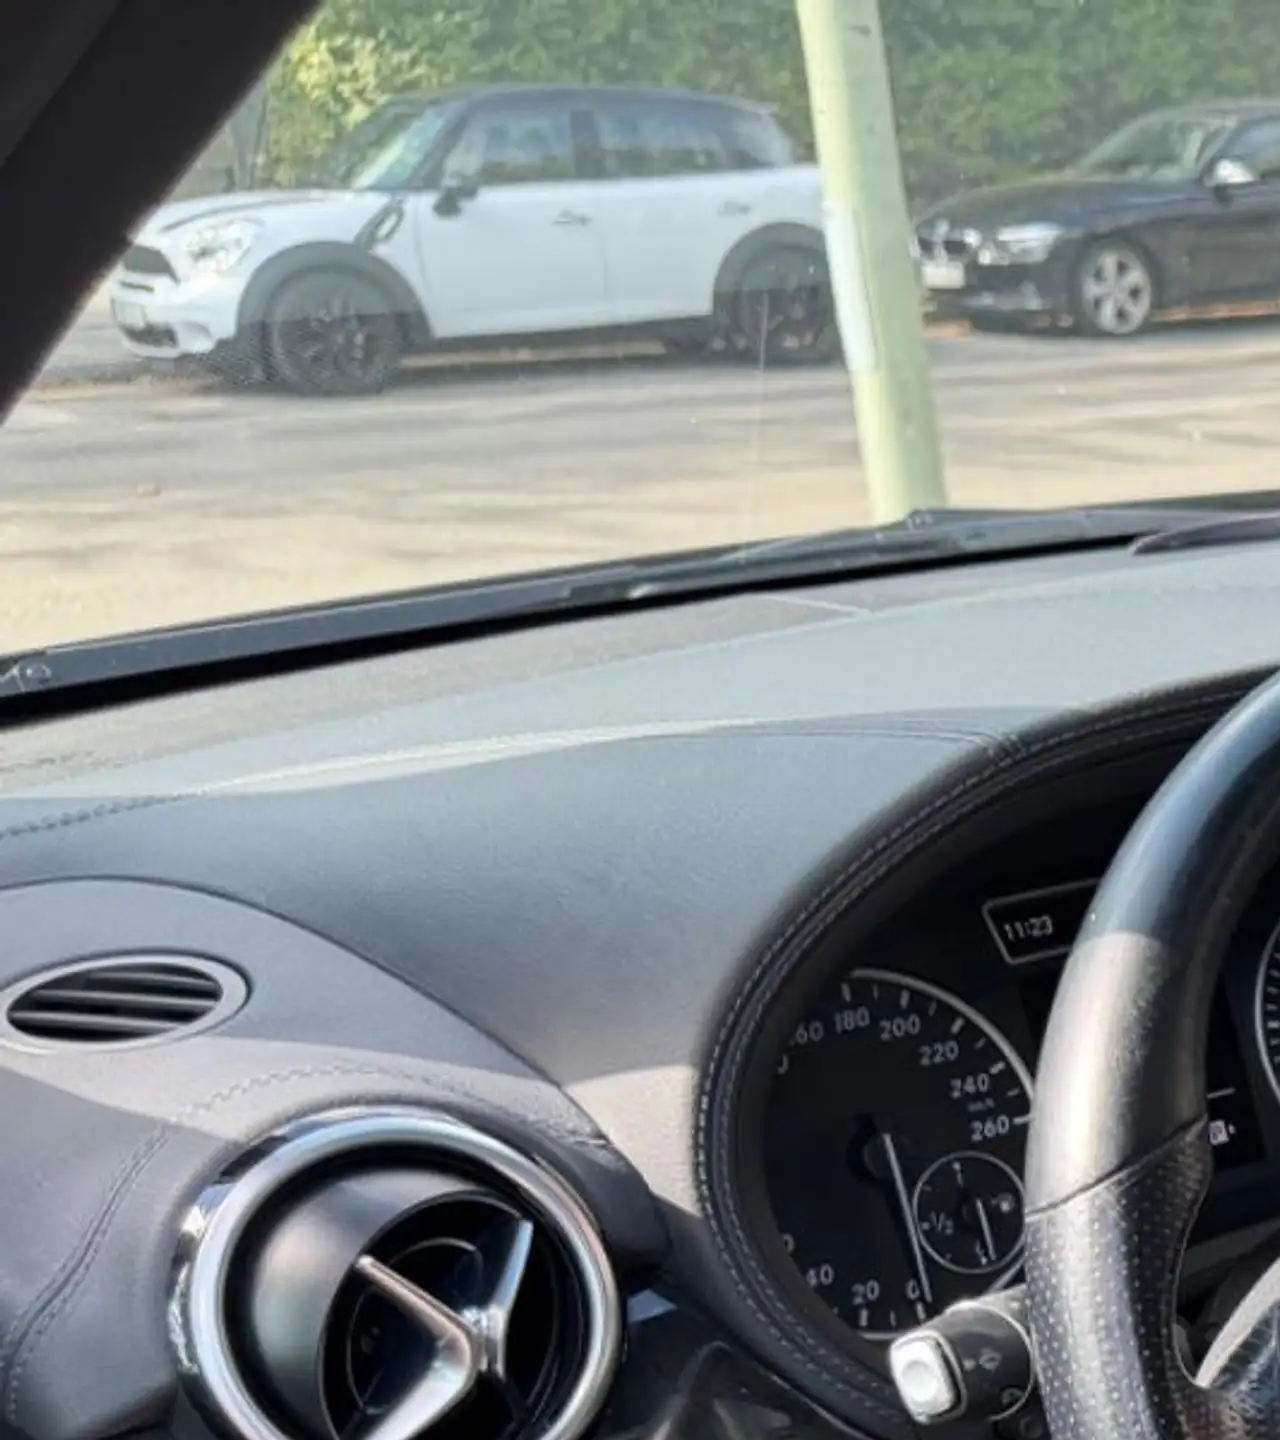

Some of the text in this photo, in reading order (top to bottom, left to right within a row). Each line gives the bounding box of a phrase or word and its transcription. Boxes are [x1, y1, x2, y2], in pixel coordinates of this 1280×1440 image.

[834, 1006, 870, 1034] 180
[879, 1014, 921, 1041] 200
[788, 1021, 824, 1046] 60
[918, 1040, 959, 1066] 220
[950, 1072, 990, 1098] 240
[970, 1115, 1010, 1143] 260
[806, 1263, 835, 1287] 40
[850, 1279, 880, 1305] 20
